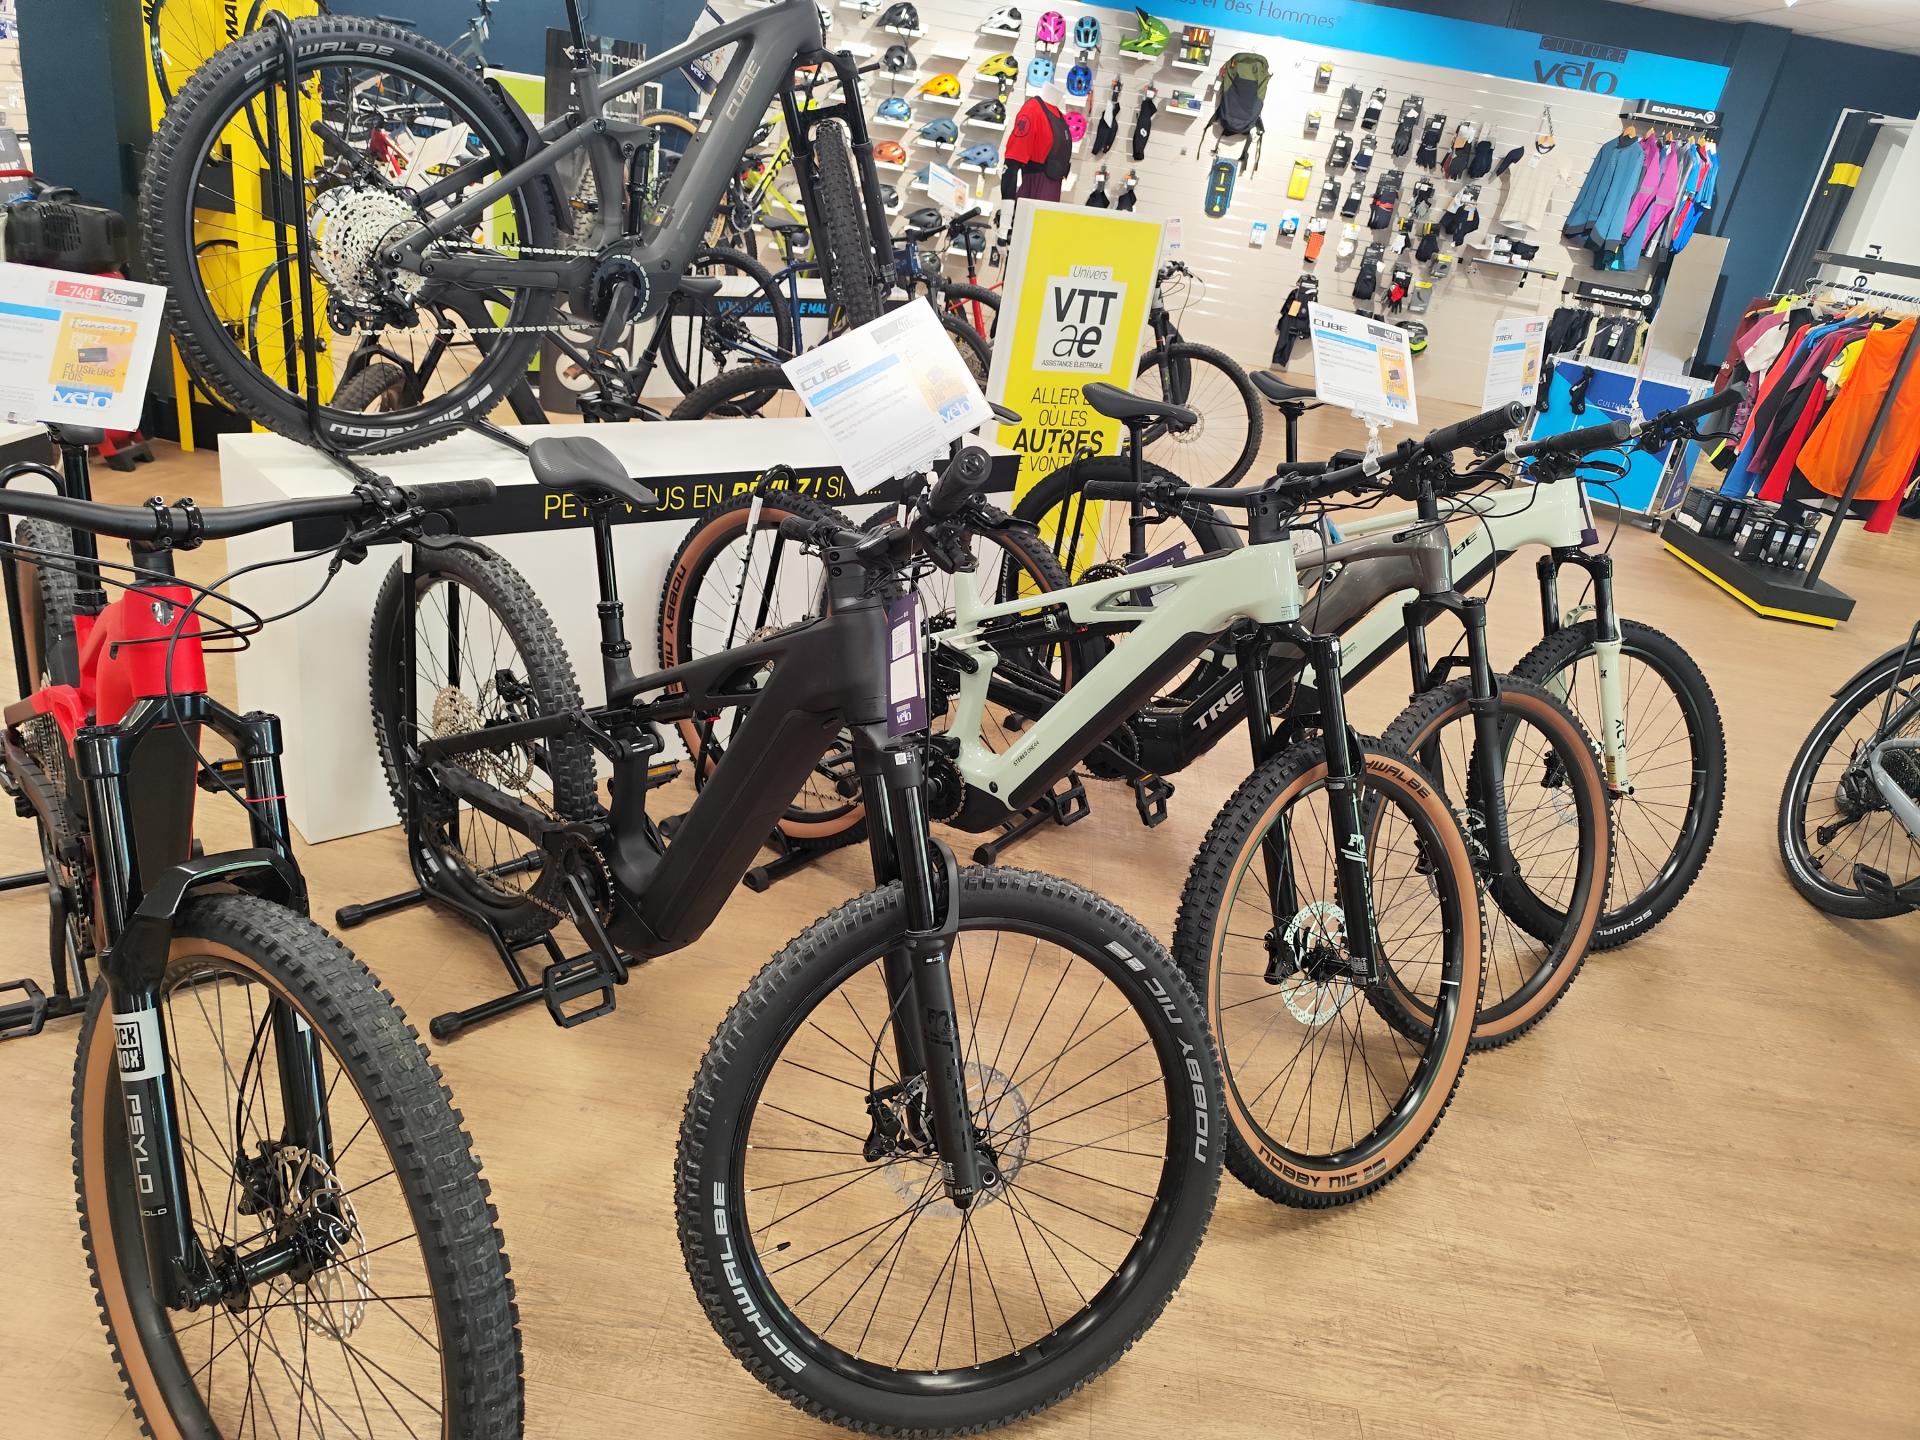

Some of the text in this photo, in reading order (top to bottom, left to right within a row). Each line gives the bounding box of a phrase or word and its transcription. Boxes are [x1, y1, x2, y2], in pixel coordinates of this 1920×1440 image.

[1258, 3, 1336, 29] Hommes
[243, 40, 396, 84] SCWALBE
[1541, 36, 1627, 64] CULTURE
[725, 60, 761, 121] CUBE
[1651, 105, 1704, 120] ENDURA
[1072, 265, 1109, 281] Univers
[1054, 286, 1118, 326] VTT
[1591, 288, 1642, 302] ENDURA
[62, 370, 83, 381] FOIS
[64, 363, 116, 378] PLUSIEURS
[800, 359, 851, 391] CUBE
[1041, 359, 1073, 368] ASSISTANCE
[1031, 387, 1080, 406] ALLER
[1038, 405, 1088, 427] OÙ LES
[1012, 428, 1104, 454] AUTRES
[693, 484, 723, 509] EN
[666, 564, 686, 634] NOBBY
[1192, 679, 1244, 731] TRE
[1143, 977, 1209, 1164] NOBBY NIC
[126, 1094, 154, 1195] PSYLO
[1258, 1144, 1358, 1188] NOBBY NIC
[954, 1186, 973, 1196] RAIL
[713, 1181, 807, 1374] SCHWALBE
